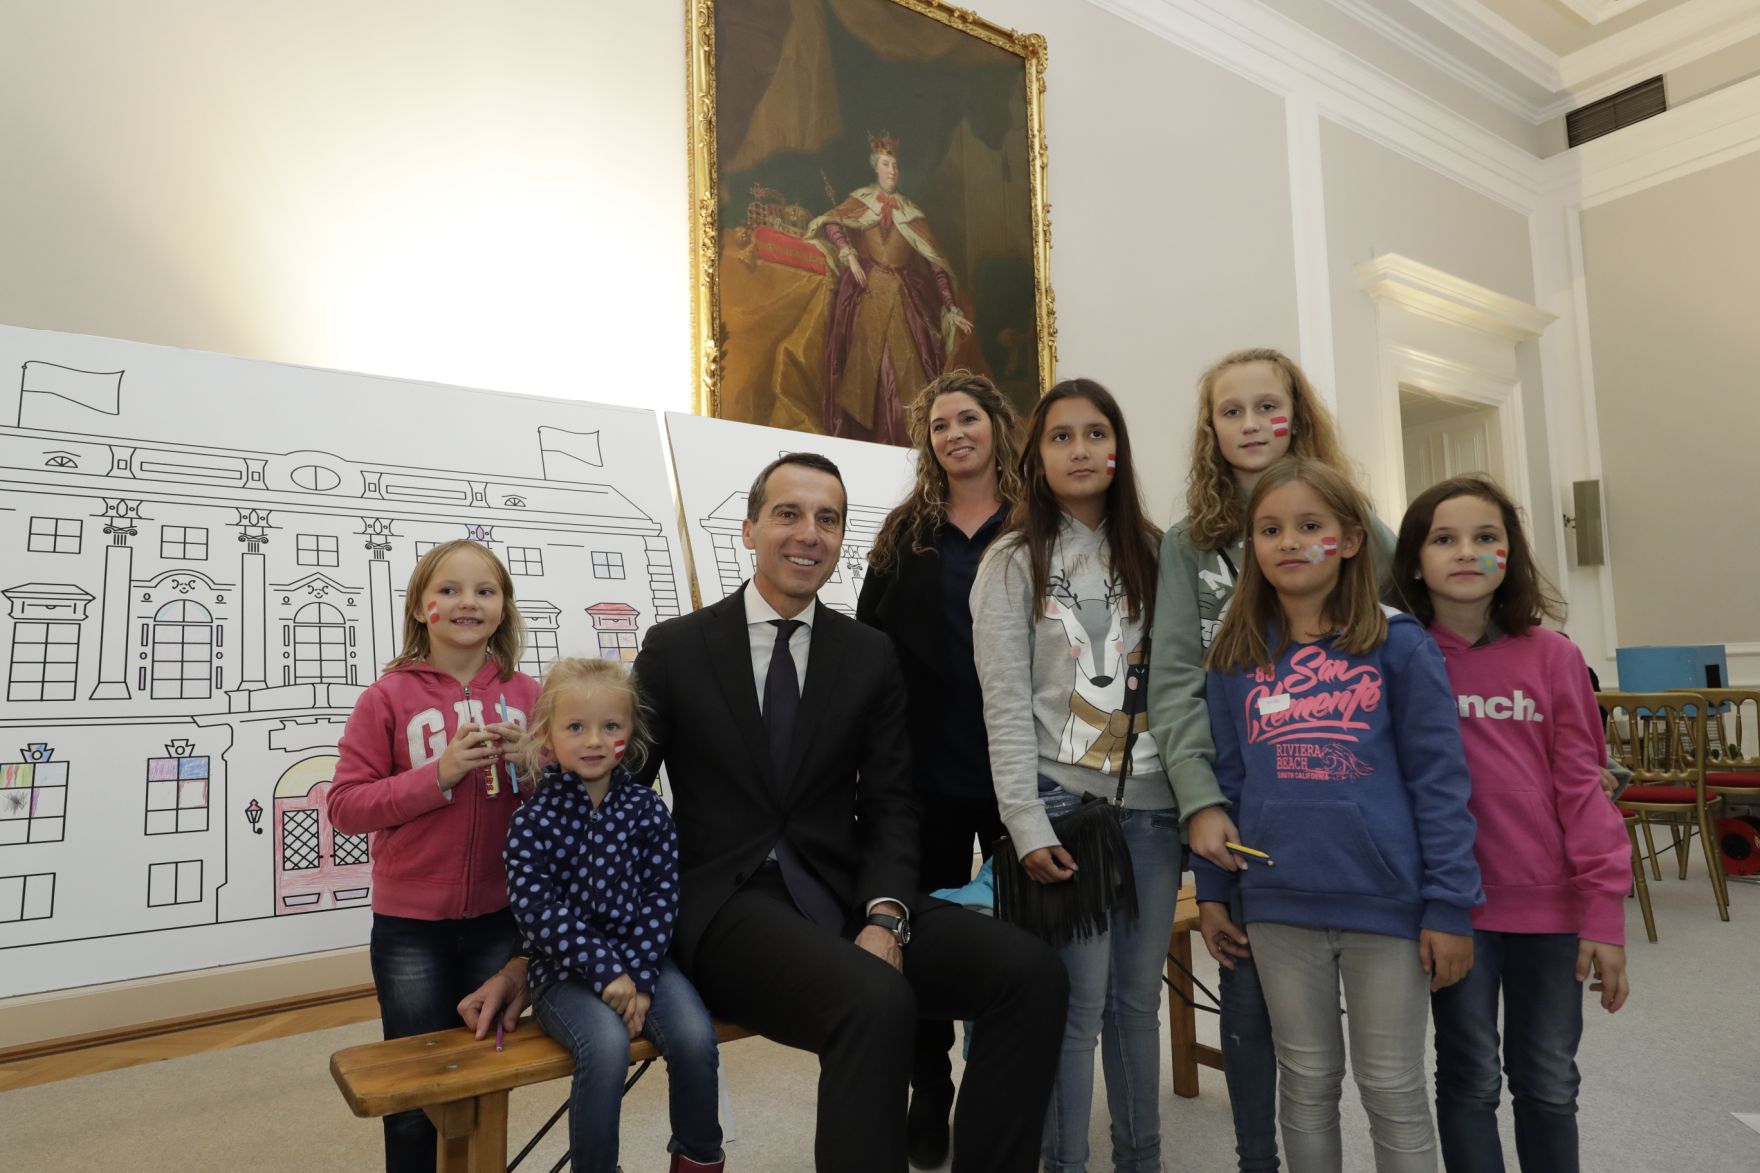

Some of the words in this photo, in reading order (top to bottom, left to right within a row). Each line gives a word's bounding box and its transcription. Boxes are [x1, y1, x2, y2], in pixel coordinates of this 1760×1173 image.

[1455, 689, 1544, 722] nch.
[1276, 744, 1321, 757] RIVIERA
[1276, 757, 1308, 770] BEACH
